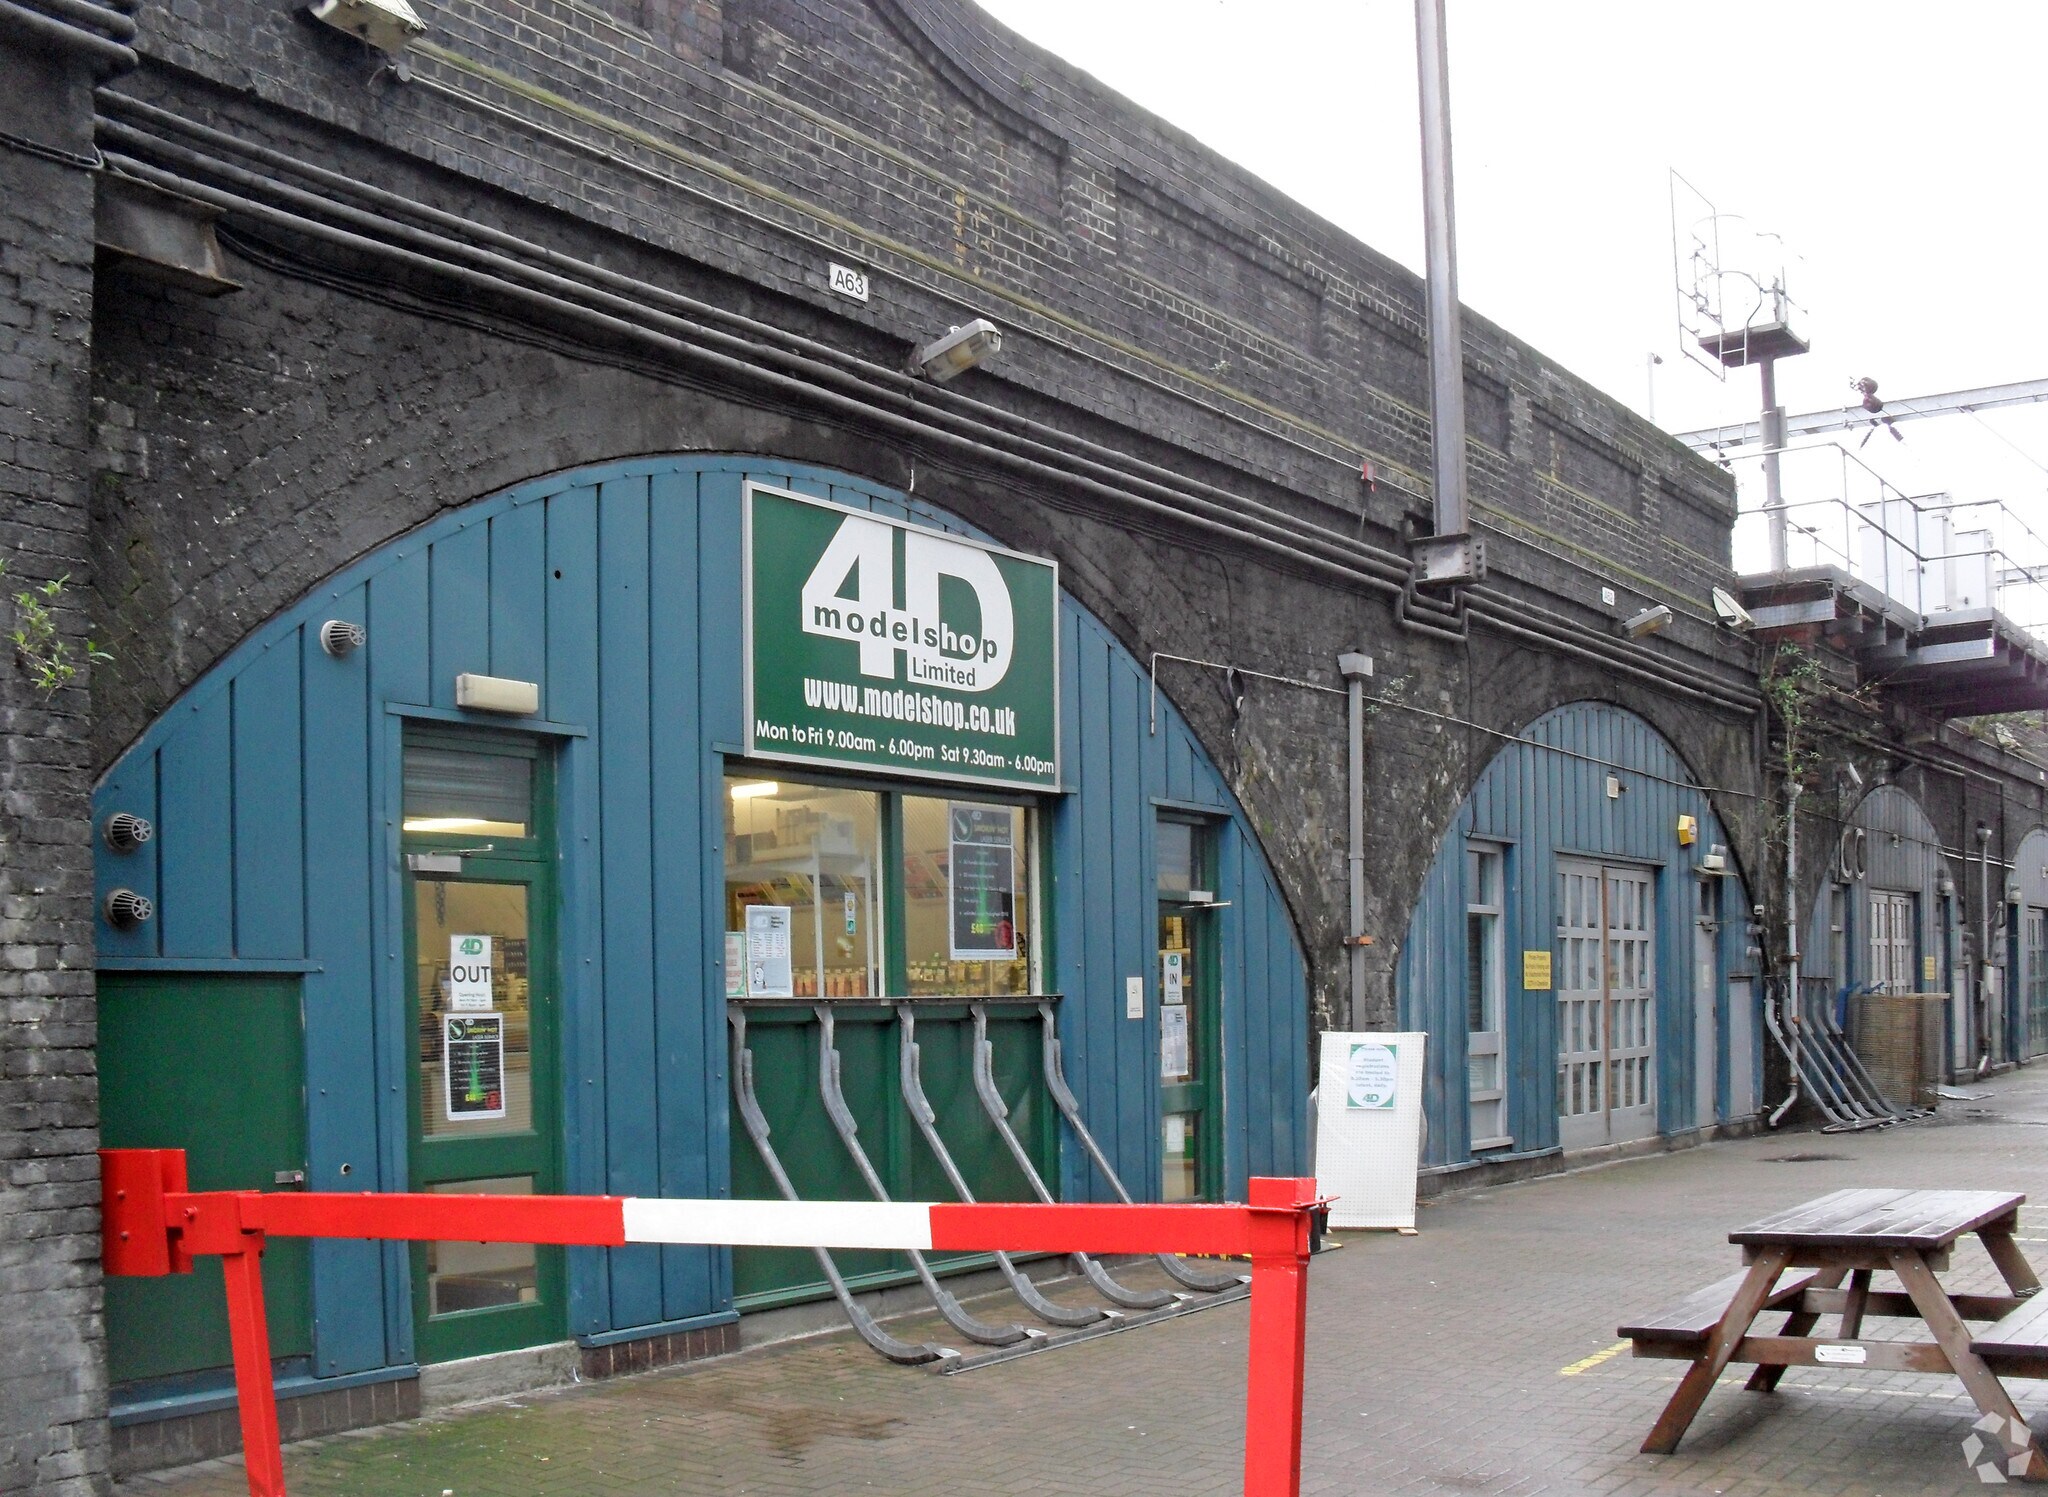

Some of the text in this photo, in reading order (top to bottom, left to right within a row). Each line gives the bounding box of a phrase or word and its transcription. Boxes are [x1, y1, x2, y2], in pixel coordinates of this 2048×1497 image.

[835, 270, 864, 295] A63
[802, 514, 1014, 692] 4D
[814, 605, 998, 663] modelshop
[912, 656, 976, 687] Limited
[803, 677, 1016, 737] www.modelshop.co.uk
[756, 719, 789, 741] Mon
[791, 724, 807, 743] to
[807, 726, 823, 745] Fri
[826, 729, 876, 752] 9.00am
[888, 737, 935, 761] 6.00pm
[940, 744, 961, 763] Sat
[962, 747, 1005, 768] 9.30am
[1015, 754, 1055, 776] 6.00pm
[460, 938, 484, 955] 4D
[452, 965, 490, 983] OUT
[1169, 973, 1178, 985] IN
